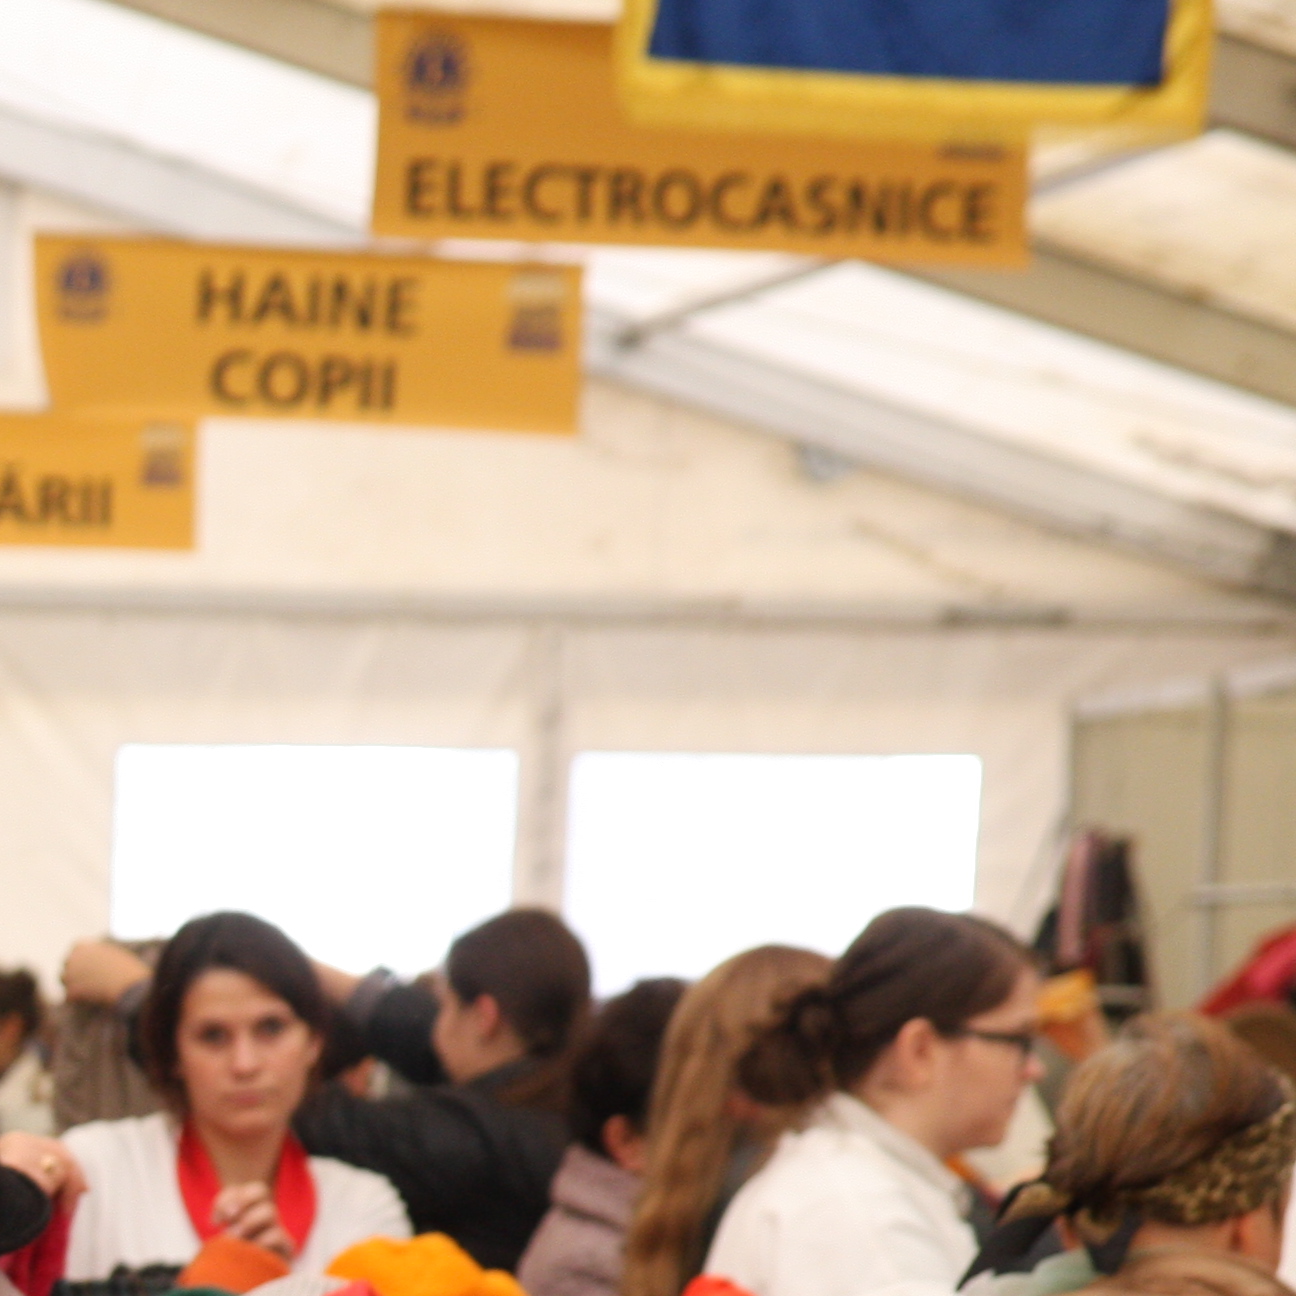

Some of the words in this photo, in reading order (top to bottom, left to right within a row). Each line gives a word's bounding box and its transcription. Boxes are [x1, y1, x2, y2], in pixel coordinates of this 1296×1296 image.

[404, 158, 1000, 244] ELECTROCASNICE
[196, 266, 419, 337] HAINE
[209, 348, 397, 412] COPII
